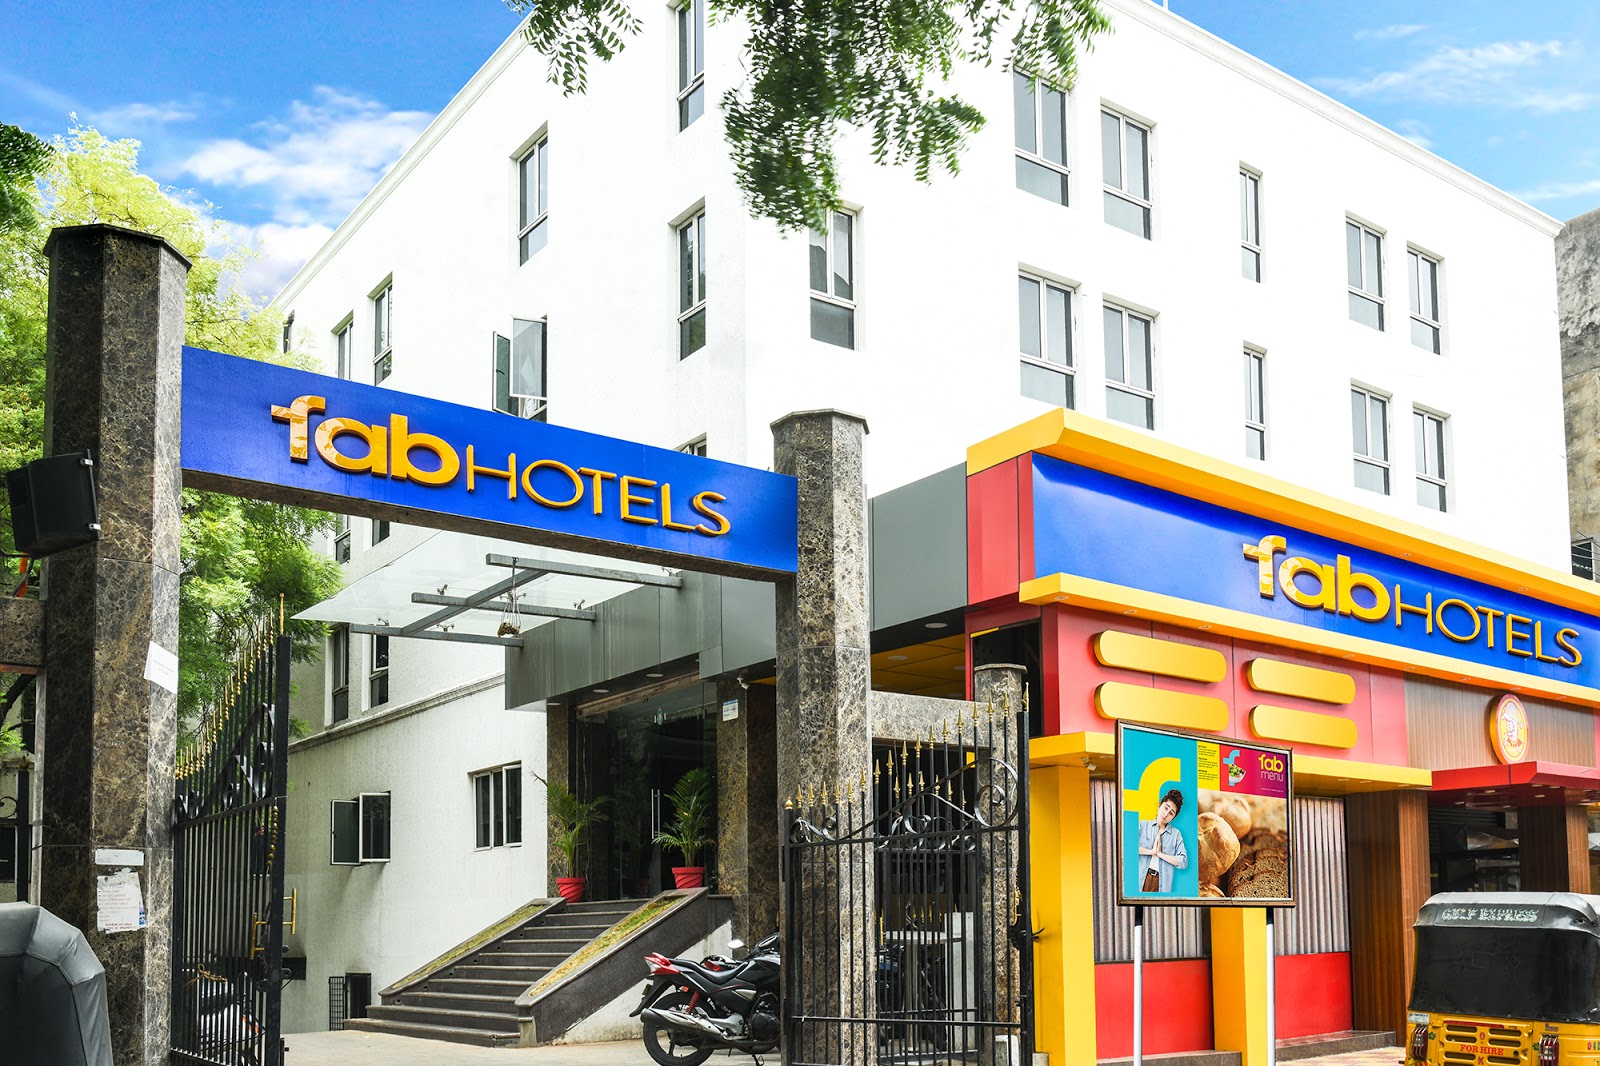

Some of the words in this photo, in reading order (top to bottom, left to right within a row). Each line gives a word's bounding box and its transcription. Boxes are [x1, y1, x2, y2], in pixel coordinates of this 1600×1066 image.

[1258, 753, 1284, 773] fab
[1260, 770, 1284, 782] menu
[1460, 1044, 1479, 1053] FOR
[1480, 1046, 1504, 1056] HIRE
